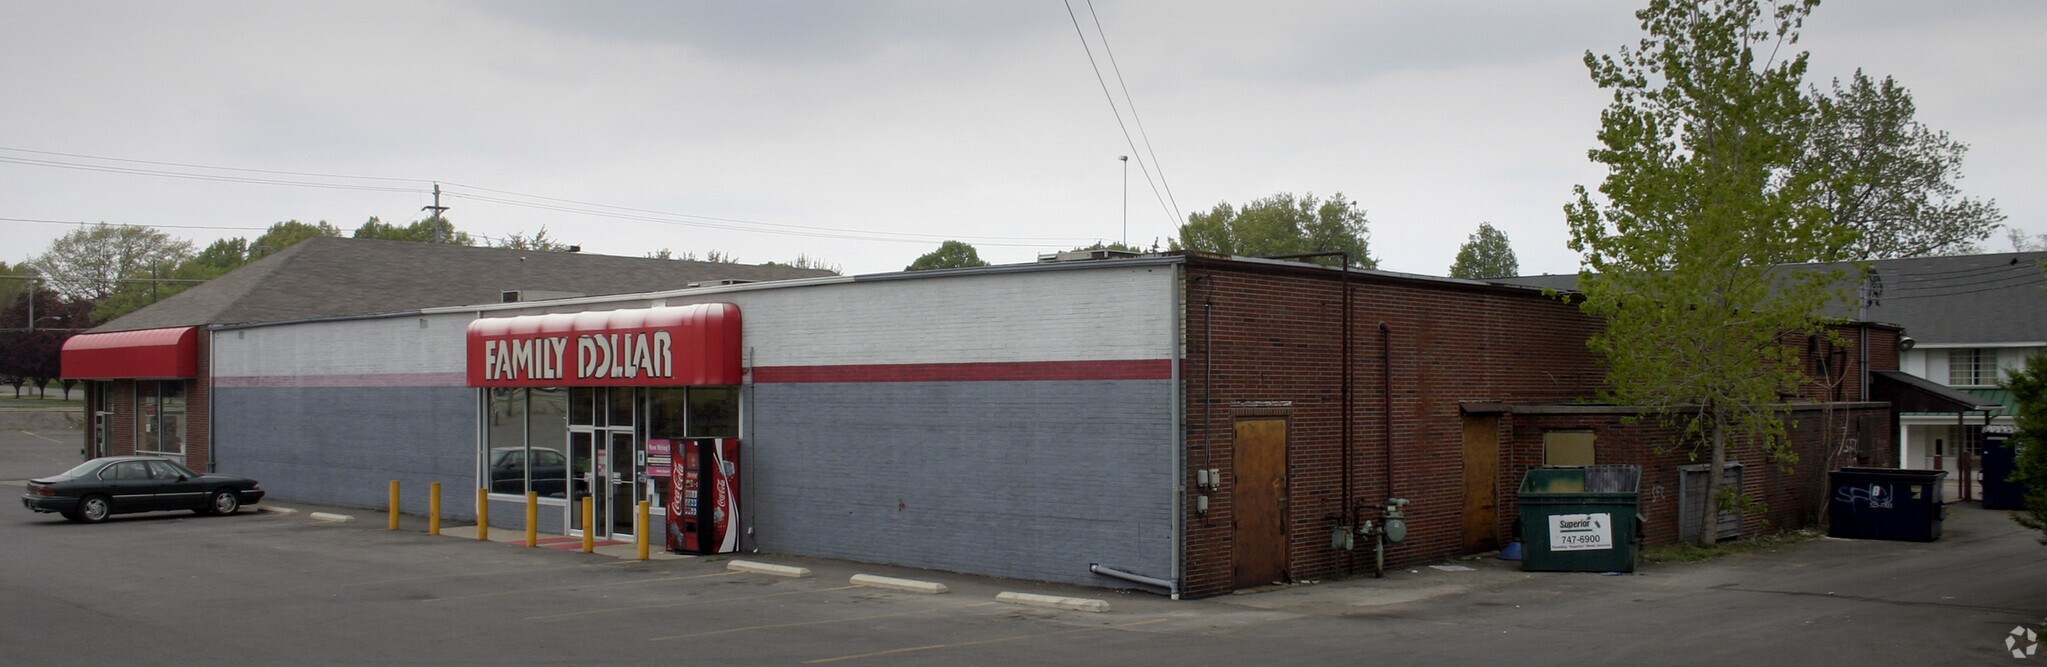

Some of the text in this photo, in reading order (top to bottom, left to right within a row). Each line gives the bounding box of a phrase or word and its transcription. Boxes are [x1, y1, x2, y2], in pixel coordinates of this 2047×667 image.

[485, 331, 673, 380] FAMILY DOLLAR
[1559, 519, 1591, 529] Superior
[1561, 534, 1601, 544] 747-6900
